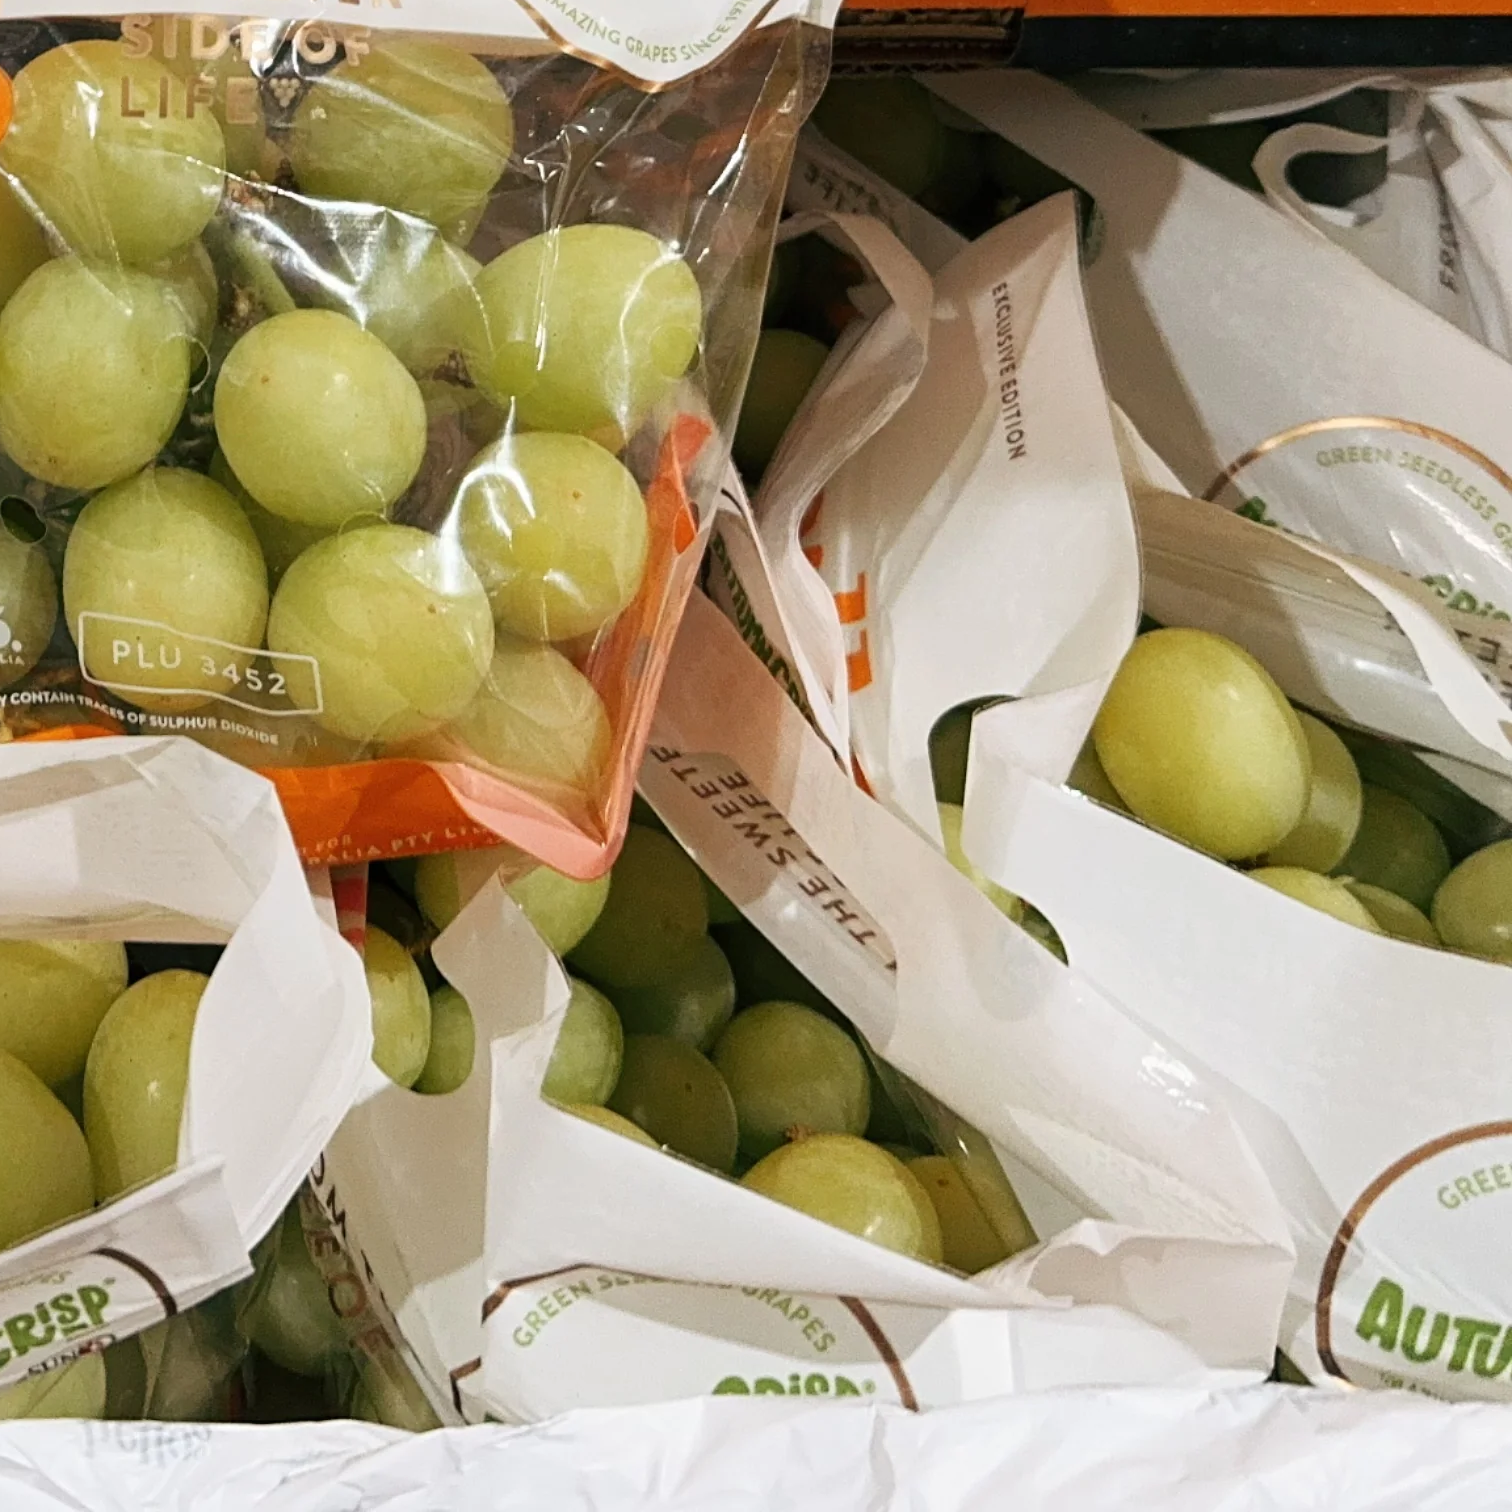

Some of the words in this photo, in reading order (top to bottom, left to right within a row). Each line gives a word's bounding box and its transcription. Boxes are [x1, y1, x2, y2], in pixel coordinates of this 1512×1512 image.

[120, 14, 273, 62] SIDE
[296, 22, 371, 67] OF
[625, 36, 678, 64] GRAPES
[680, 23, 731, 61] SINCE
[120, 76, 259, 126] LIFE
[991, 281, 1017, 377] EXCLUSIVE
[999, 378, 1027, 461] EDITION
[1315, 445, 1392, 469] GREEN
[1396, 450, 1499, 521] SEEDLESS
[112, 639, 182, 670] PLU
[200, 655, 287, 696] 3452
[9, 690, 76, 707] CONTAIN
[76, 694, 126, 721] TRACES
[127, 711, 148, 727] OF
[149, 714, 218, 731] SULPHUR
[220, 719, 280, 747] DIOXIDE
[1436, 1162, 1512, 1211] GREE
[511, 1279, 592, 1349] GREEN
